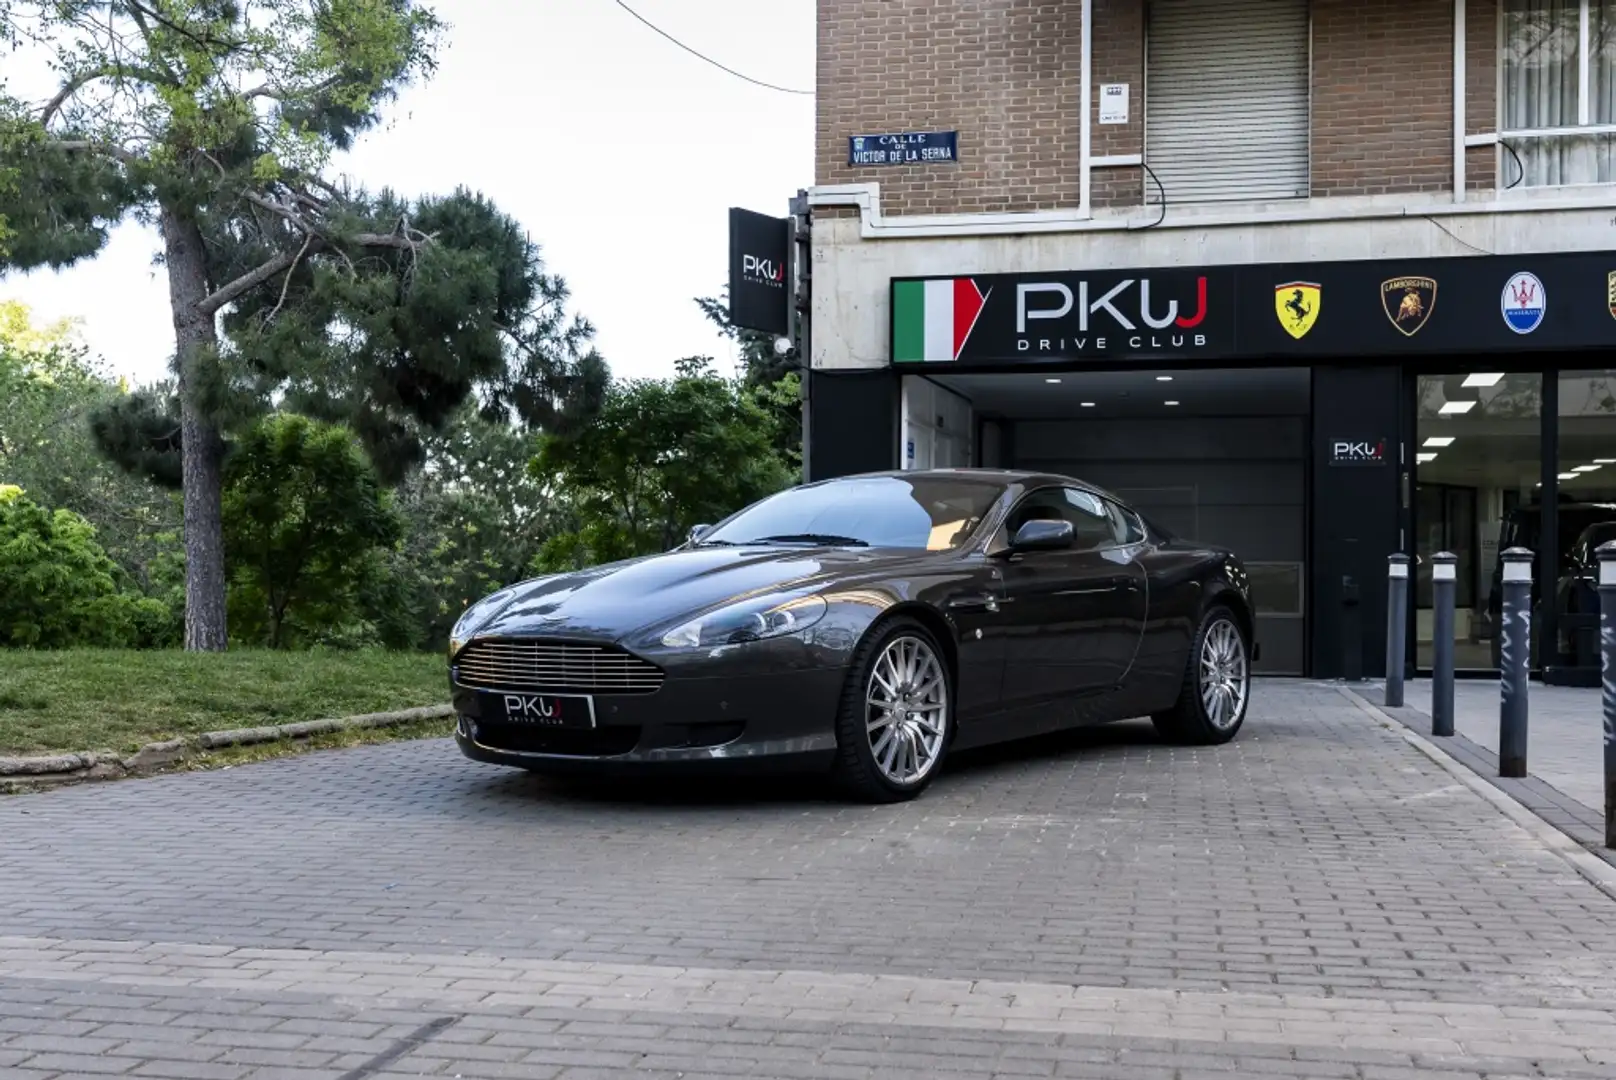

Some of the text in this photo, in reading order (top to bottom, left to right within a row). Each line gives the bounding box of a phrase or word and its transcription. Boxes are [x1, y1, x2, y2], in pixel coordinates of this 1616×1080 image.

[879, 134, 927, 145] CALLE
[853, 147, 952, 163] VICTOR DE LA SERNA
[1017, 334, 1206, 350] DRIVE CLUB
